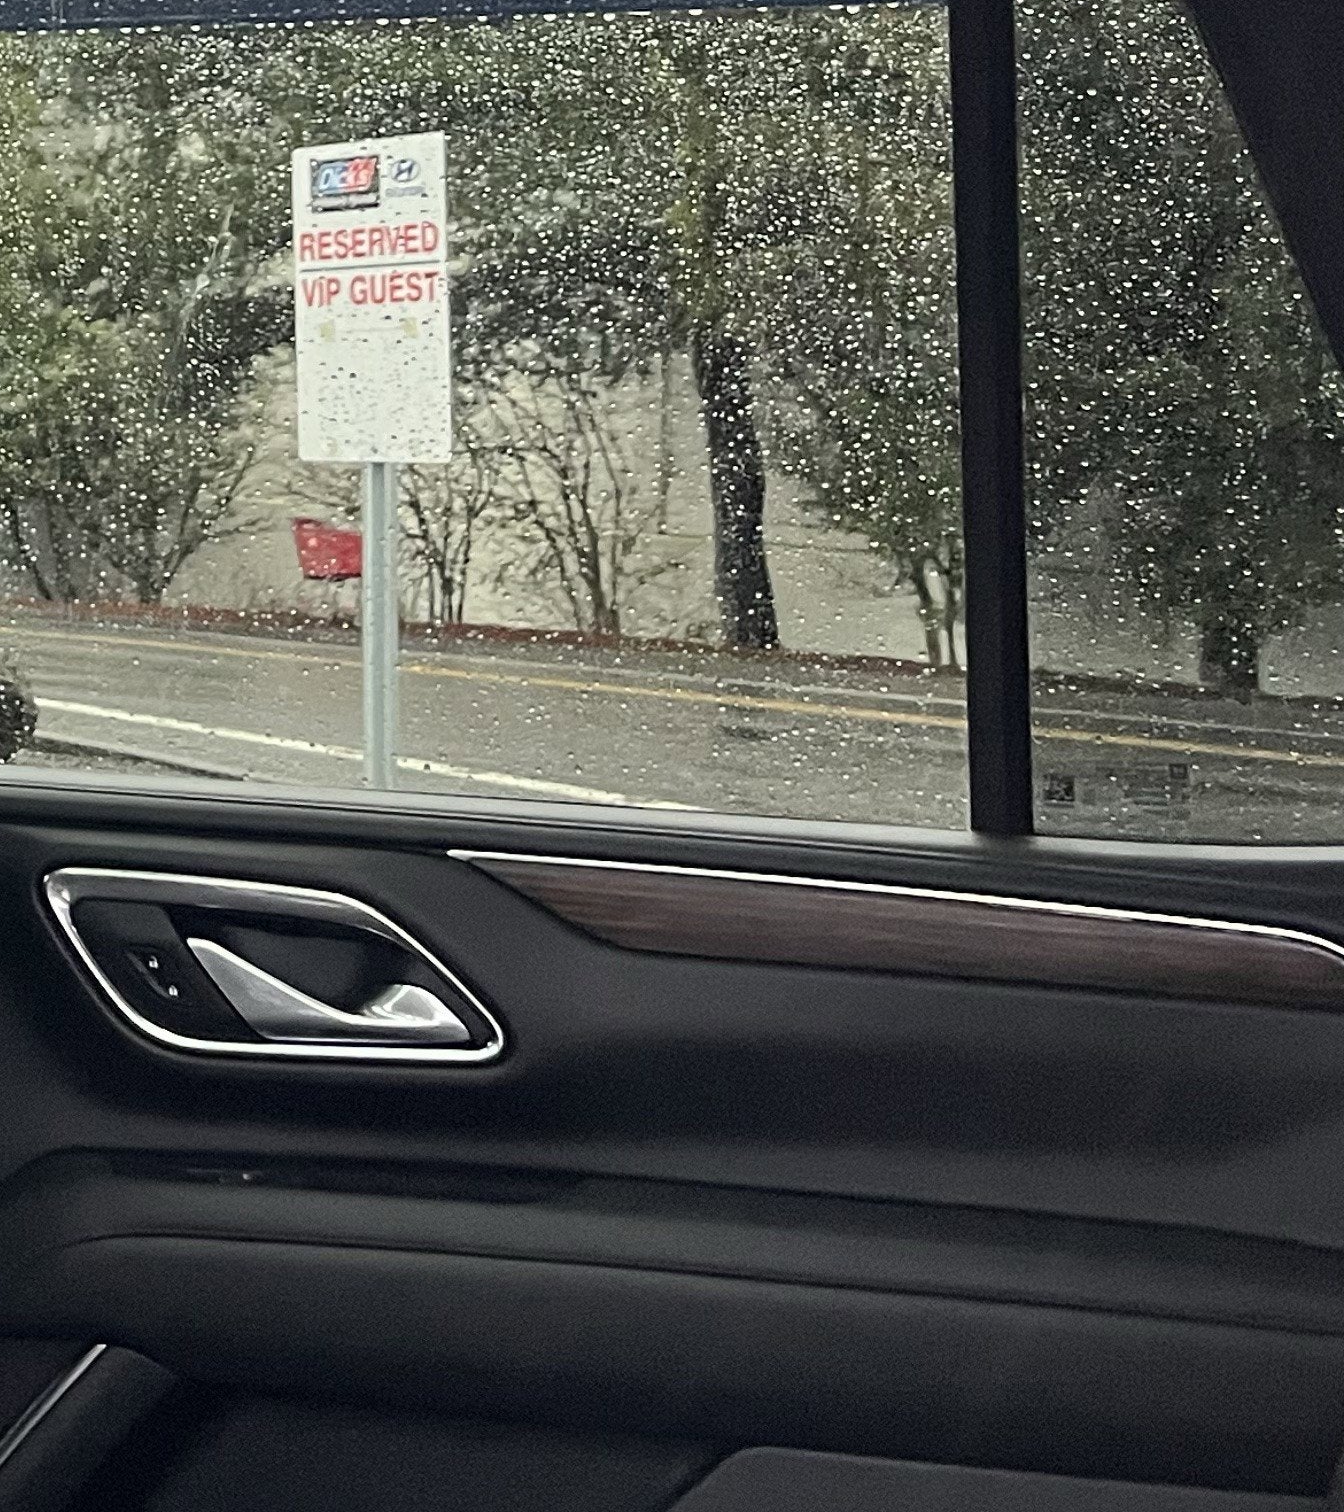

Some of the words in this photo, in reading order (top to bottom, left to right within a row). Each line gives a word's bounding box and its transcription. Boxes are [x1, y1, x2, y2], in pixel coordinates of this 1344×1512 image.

[299, 220, 439, 261] RESERVED
[301, 276, 341, 308] VIP
[350, 271, 439, 305] GUEST
